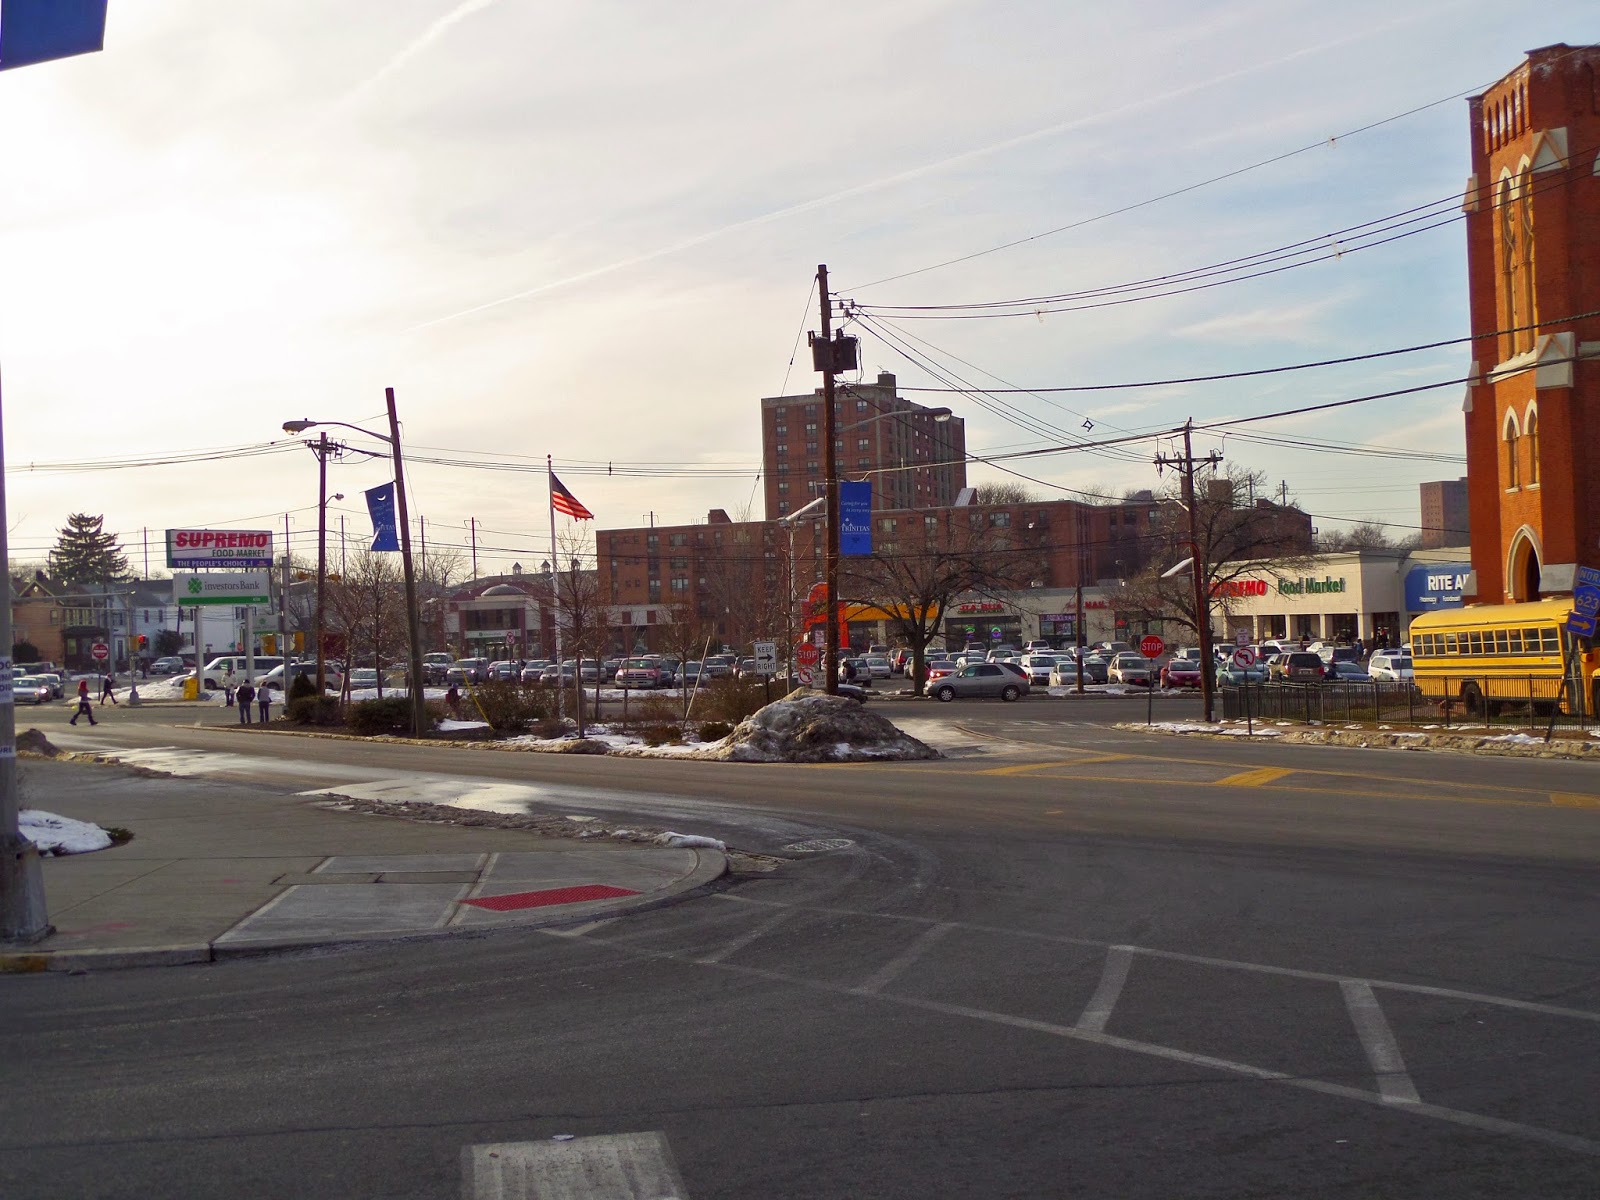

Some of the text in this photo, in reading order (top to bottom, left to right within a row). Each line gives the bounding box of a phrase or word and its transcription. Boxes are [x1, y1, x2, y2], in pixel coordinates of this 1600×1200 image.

[841, 524, 870, 532] TRINITAS
[176, 532, 268, 548] SUPREMO
[212, 549, 266, 557] FOOD MARKET
[1427, 573, 1470, 591] RITE AI
[1580, 571, 1600, 584] NOR
[1278, 577, 1304, 594] Food
[1305, 576, 1345, 594] Market
[1577, 595, 1599, 610] 623
[757, 645, 774, 653] KEEP
[1142, 642, 1163, 651] STOP
[798, 650, 817, 659] STOP
